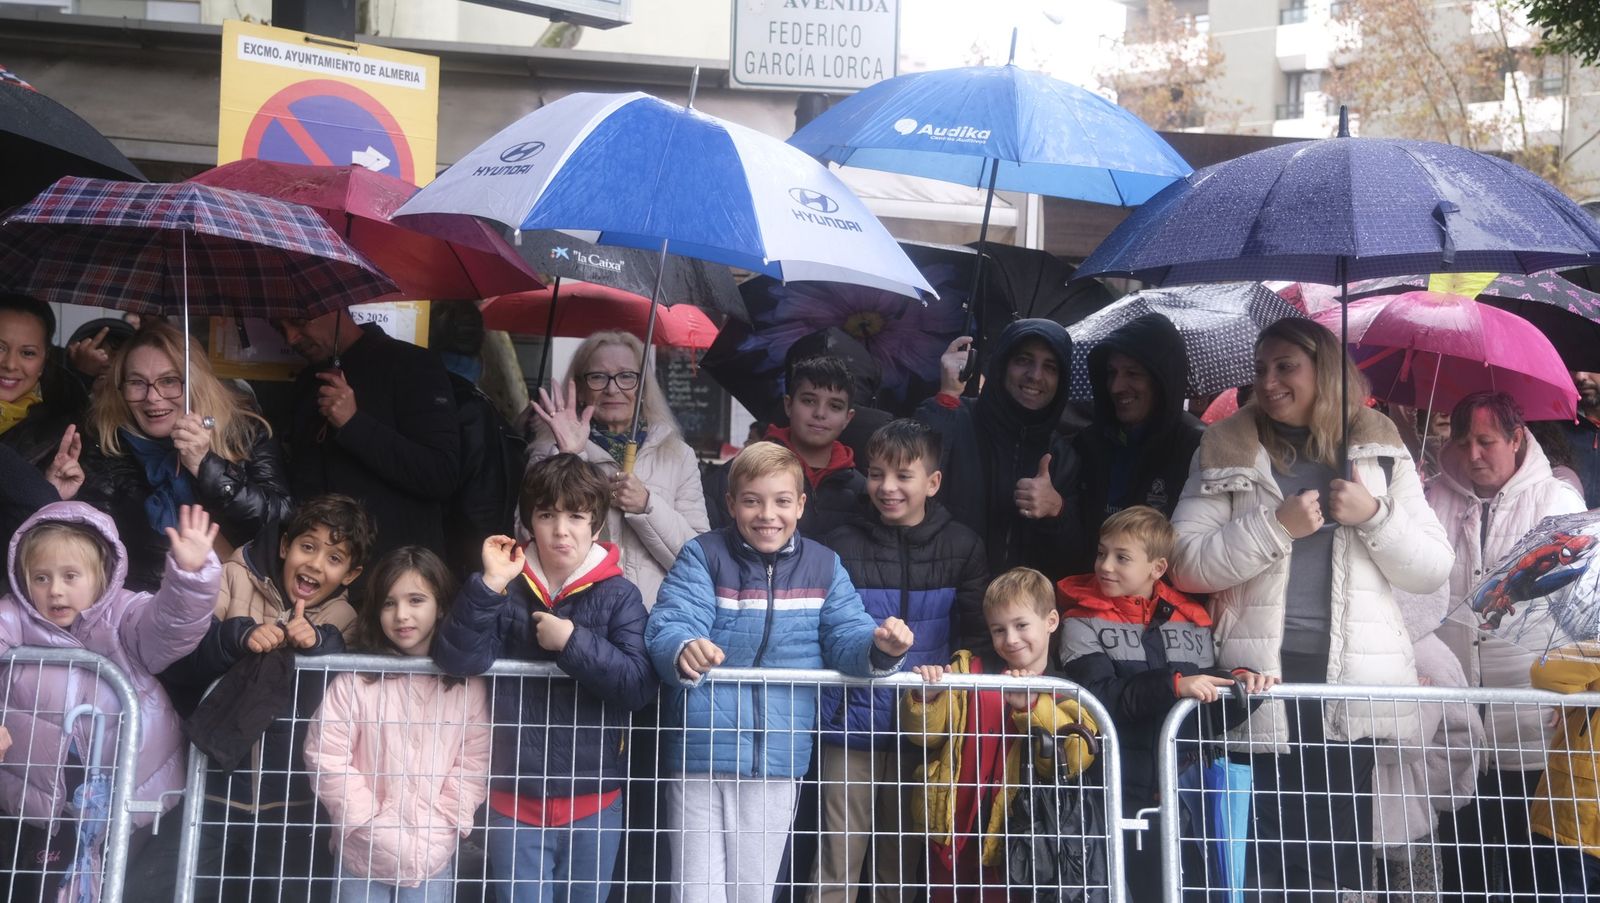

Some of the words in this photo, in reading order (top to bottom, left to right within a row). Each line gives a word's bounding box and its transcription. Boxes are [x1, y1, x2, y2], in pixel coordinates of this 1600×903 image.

[783, 0, 889, 13] AVENIDA
[769, 21, 862, 48] FEDERICO
[243, 42, 282, 60] EXCMO.
[285, 50, 361, 73] AYUNTAMIENTO
[364, 64, 376, 76] DE
[379, 66, 420, 83] ALMERIA
[745, 47, 815, 77] GARCÍA
[823, 55, 884, 80] LORCA
[917, 124, 991, 140] Audika
[472, 164, 535, 176] HYUNDAI
[792, 208, 863, 233] HYUNDAI
[351, 311, 364, 321] ES
[366, 312, 389, 323] 2026
[1098, 627, 1203, 656] GUESS
